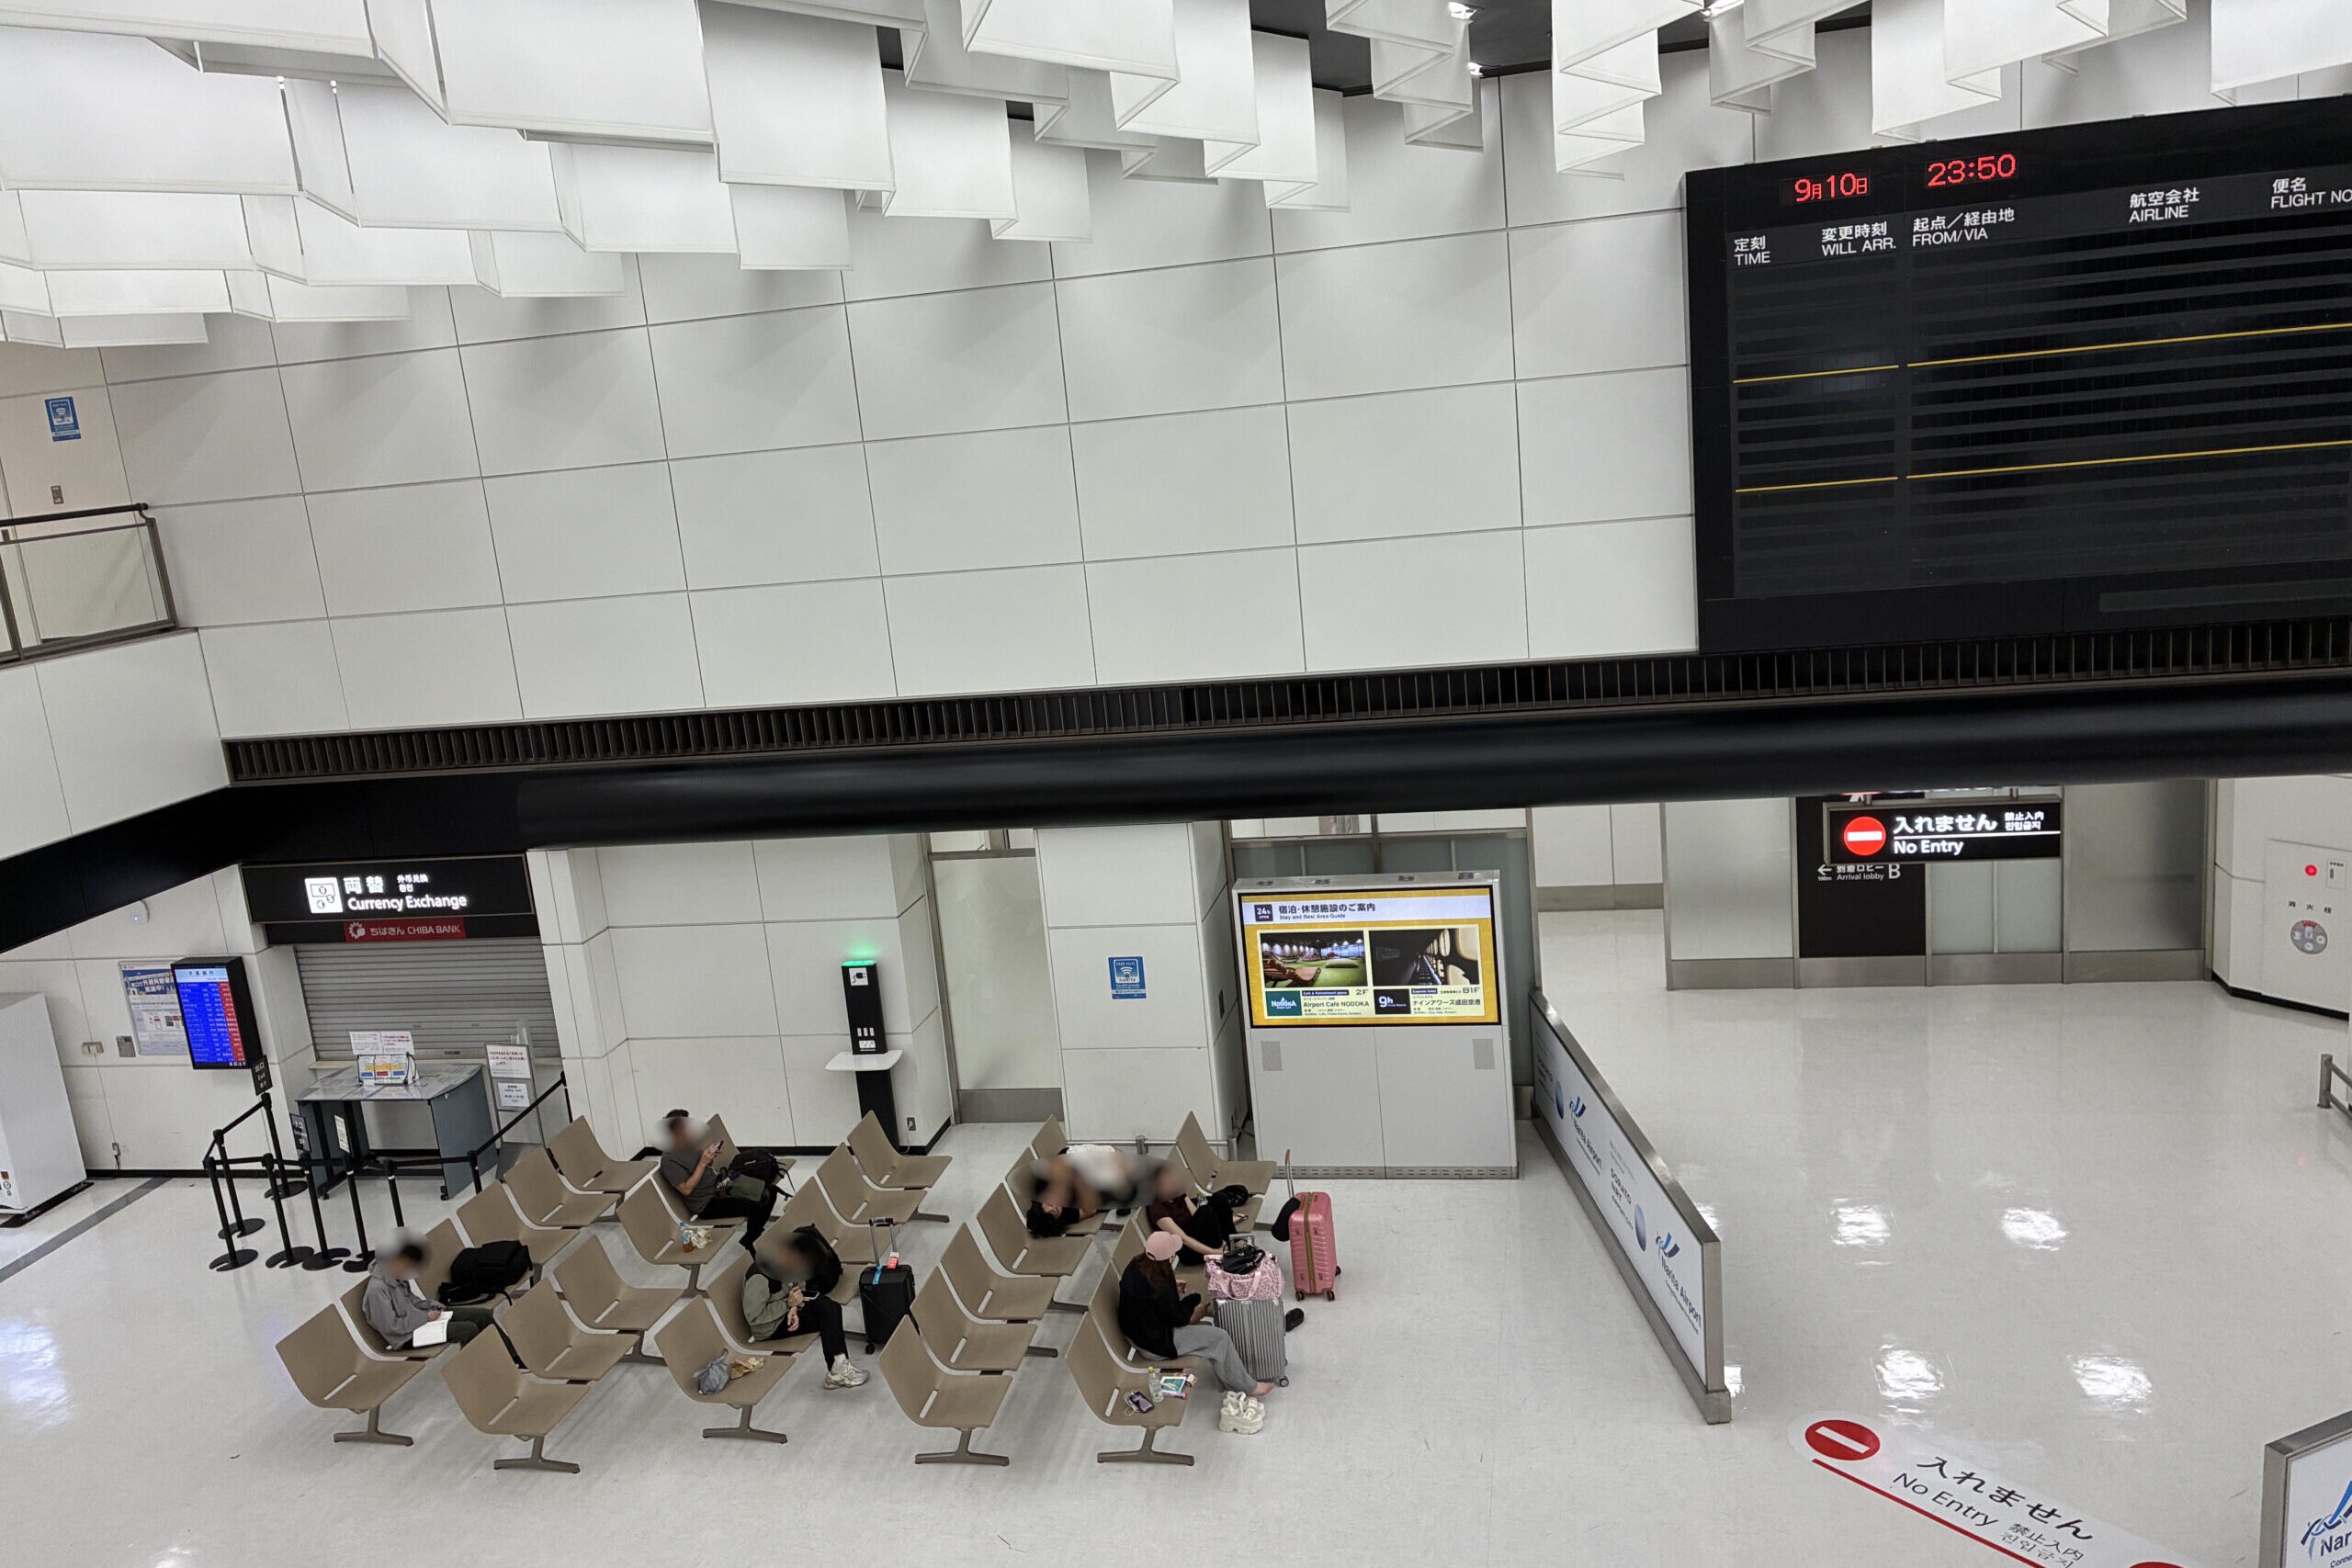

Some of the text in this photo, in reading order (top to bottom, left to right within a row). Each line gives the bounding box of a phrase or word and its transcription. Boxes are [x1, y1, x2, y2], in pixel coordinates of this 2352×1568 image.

[1927, 153, 2017, 186] 23:50
[1794, 173, 1868, 202] 9月10日
[2272, 177, 2307, 195] 便名
[2130, 186, 2200, 209] 航空会社
[2270, 191, 2326, 209] FLIGHT
[2129, 205, 2189, 223] AIRLINE
[1821, 221, 1888, 243] 変更時刻
[1735, 235, 1766, 252] 定刻
[1821, 237, 1897, 256] WILL ARR.
[1735, 251, 1771, 266] TIME
[1893, 814, 1997, 835] 入れません
[1893, 839, 1964, 856] No Entry
[1862, 873, 1884, 881] lobby
[1888, 863, 1901, 879] B
[343, 875, 384, 894] 両替
[347, 894, 468, 912] Currency Exchange
[369, 927, 405, 936] ちばぎん
[407, 925, 461, 935] CHIBA BANK
[1661, 1254, 1679, 1292] Narita
[1679, 1285, 1702, 1328] Airport
[1893, 1472, 1999, 1527] No Entry
[1917, 1456, 2093, 1540] 入れません
[2007, 1522, 2085, 1562] 禁止入内
[2320, 1531, 2352, 1557] Nar
